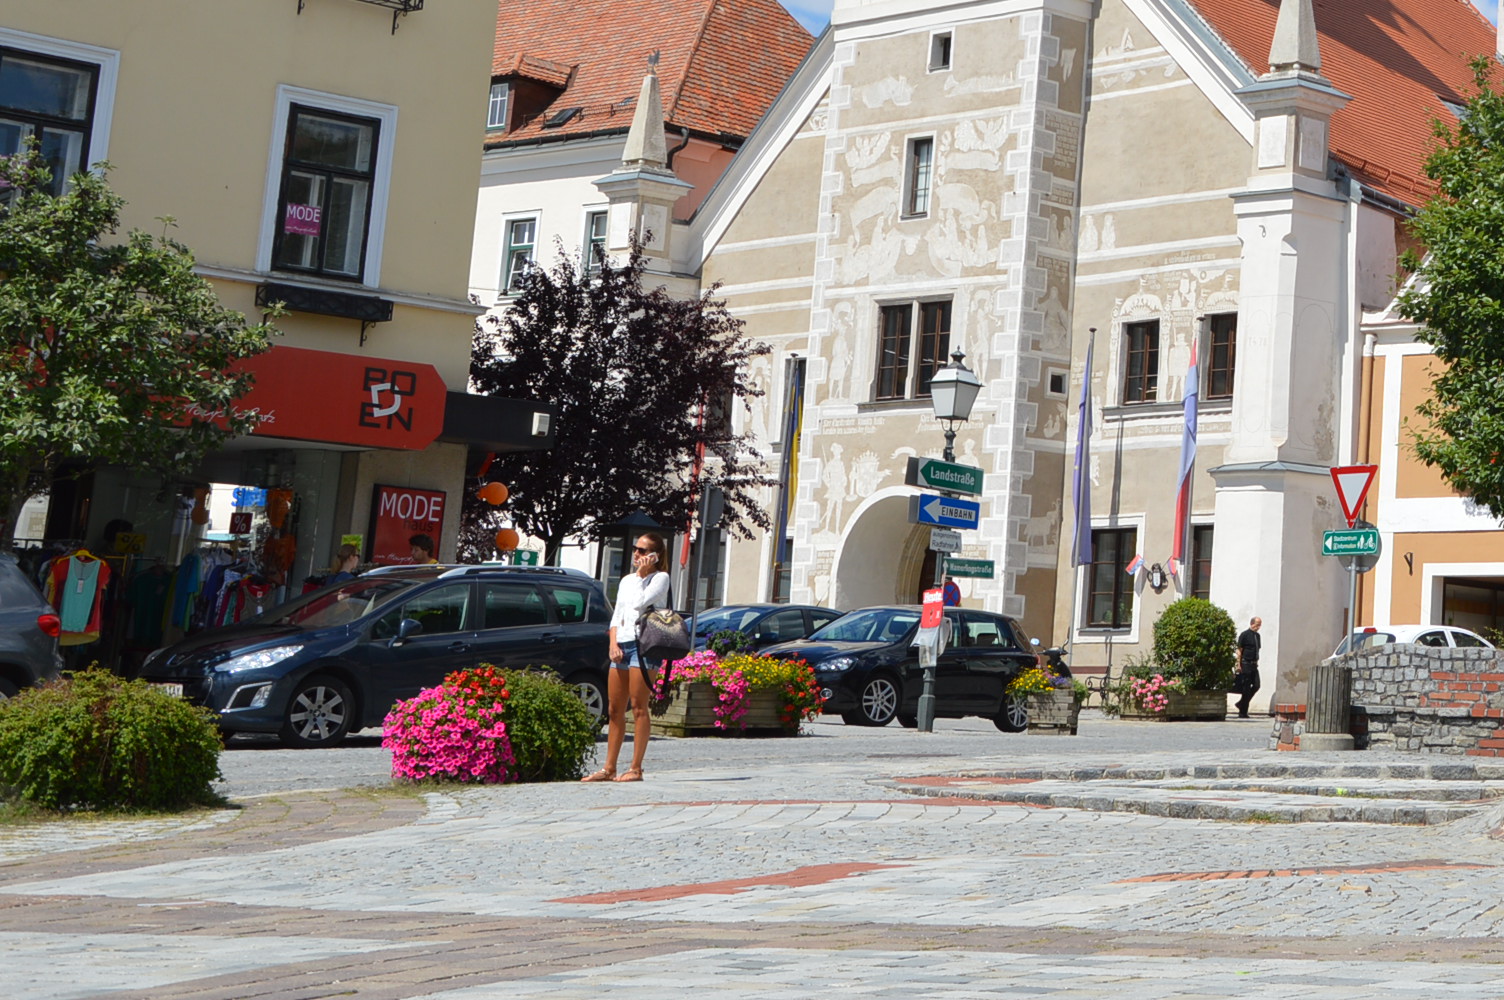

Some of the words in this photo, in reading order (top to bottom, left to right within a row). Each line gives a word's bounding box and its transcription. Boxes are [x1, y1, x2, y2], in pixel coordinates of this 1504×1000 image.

[286, 205, 321, 223] MODE
[930, 466, 975, 486] Landstraße
[380, 492, 442, 522] MODE
[941, 507, 973, 520] EINBAHN
